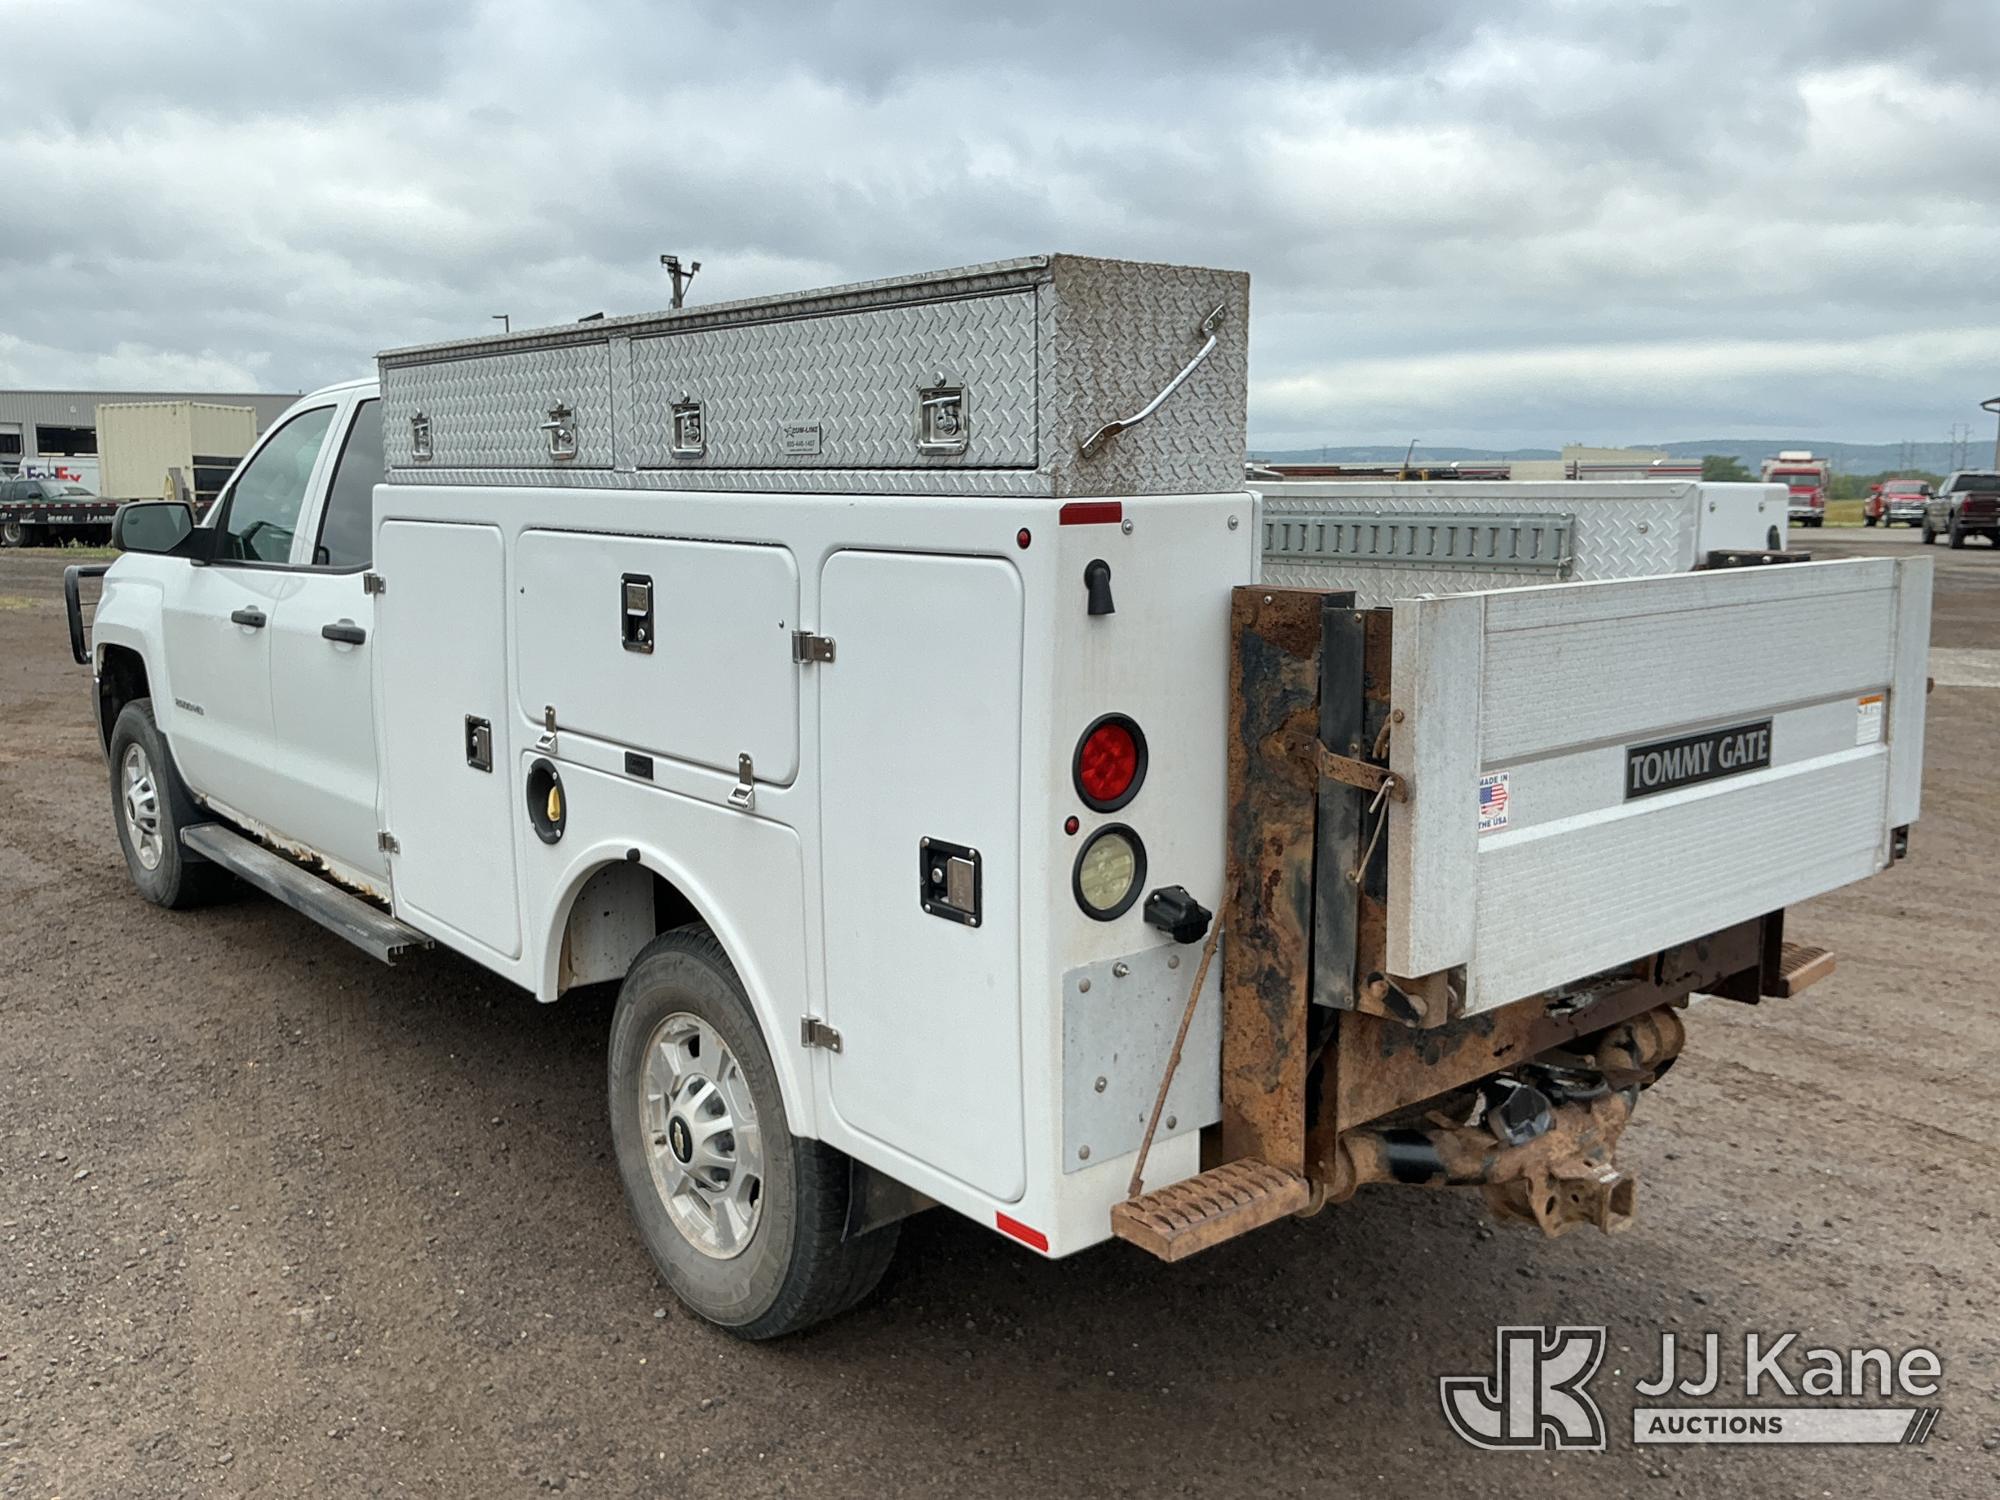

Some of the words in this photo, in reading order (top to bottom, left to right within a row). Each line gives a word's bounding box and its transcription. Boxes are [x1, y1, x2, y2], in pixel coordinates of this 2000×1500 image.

[1631, 740, 1714, 789] TOMMY
[1718, 729, 1768, 769] GATE
[1480, 776, 1498, 786] MADE
[1500, 774, 1508, 782] IN
[1478, 820, 1491, 830] THE
[1493, 816, 1507, 826] USA
